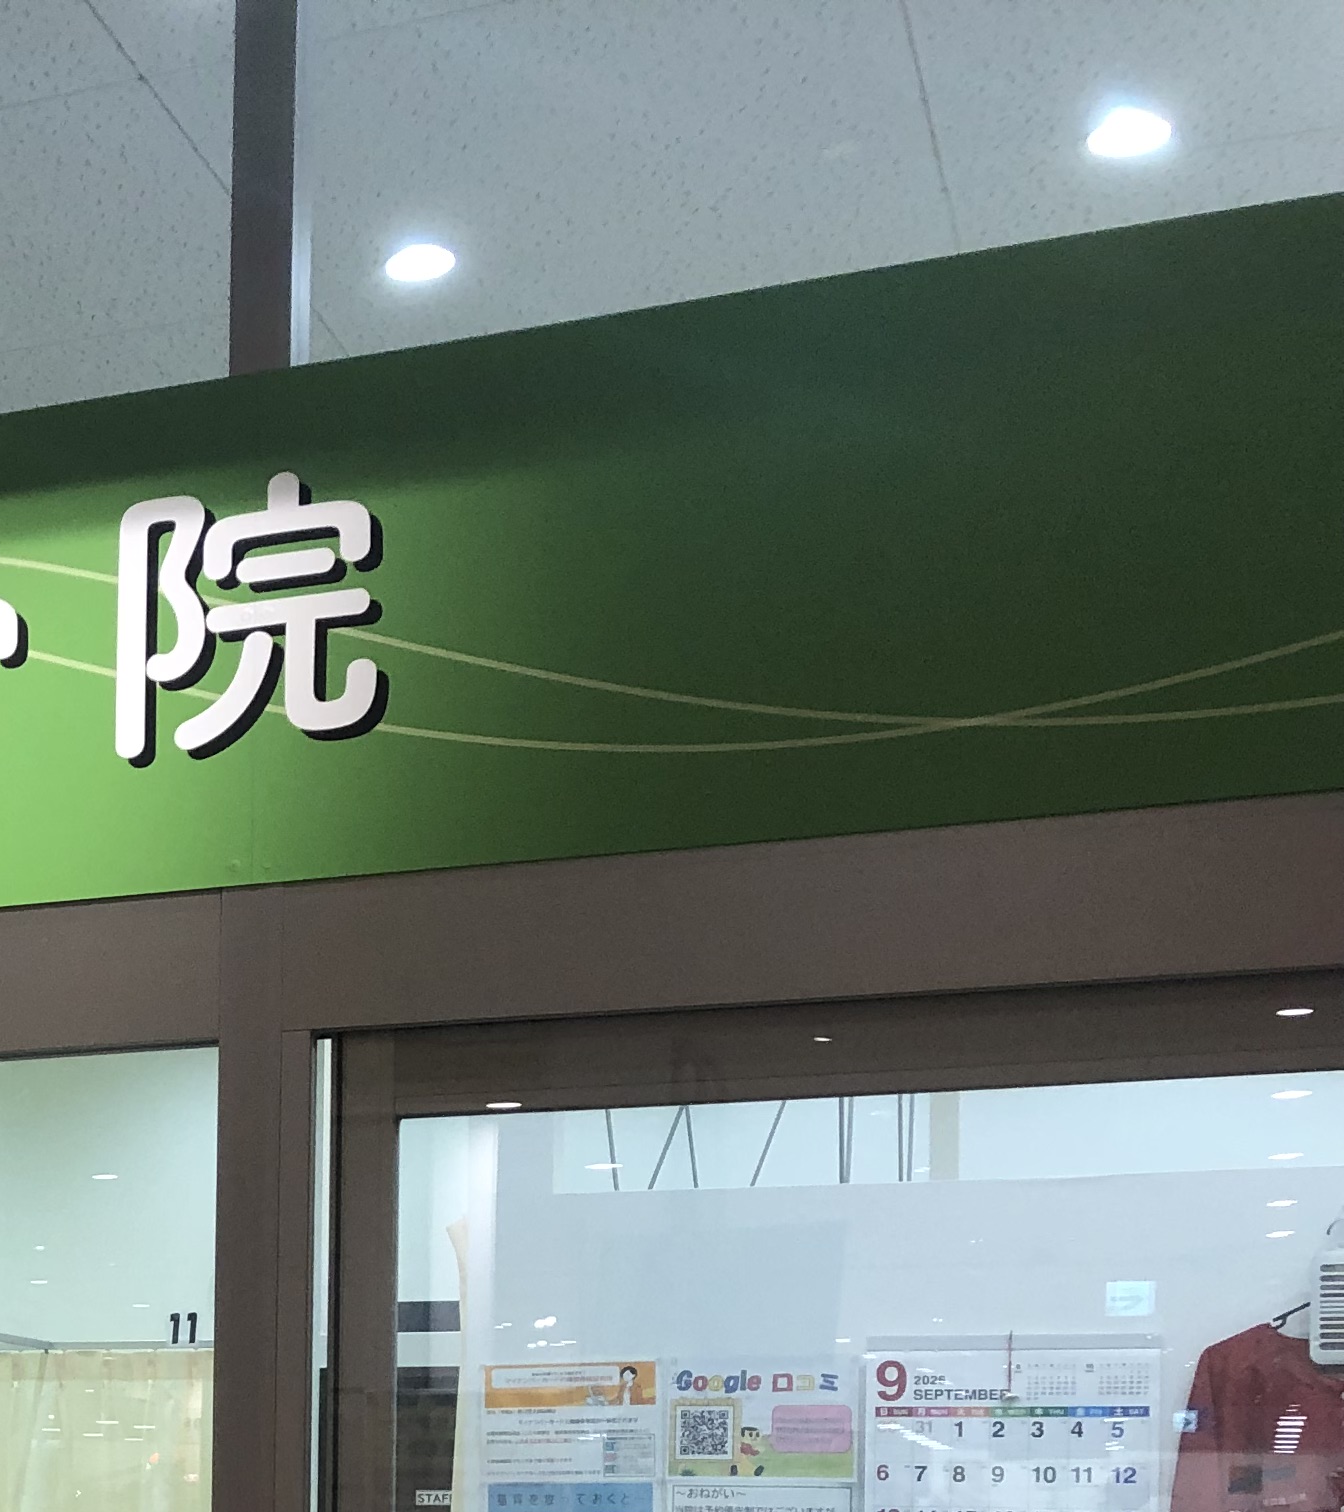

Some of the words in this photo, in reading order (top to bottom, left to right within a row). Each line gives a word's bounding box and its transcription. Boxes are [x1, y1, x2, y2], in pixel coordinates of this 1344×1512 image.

[170, 1312, 198, 1344] 11
[675, 1370, 762, 1394] Google
[876, 1360, 907, 1402] 9
[913, 1388, 1011, 1401] SEPTEMBER
[954, 1422, 963, 1437] 1
[992, 1421, 1005, 1437] 2
[1031, 1421, 1044, 1437] 3
[1071, 1421, 1084, 1437] 4
[1112, 1422, 1124, 1438] 5
[876, 1465, 889, 1481] 6
[914, 1466, 927, 1481] 7
[952, 1466, 966, 1482] 8
[991, 1466, 1004, 1482] 9
[1032, 1466, 1057, 1483] 10
[1071, 1467, 1092, 1483] 11
[1113, 1467, 1137, 1484] 12
[417, 1493, 452, 1503] STAF
